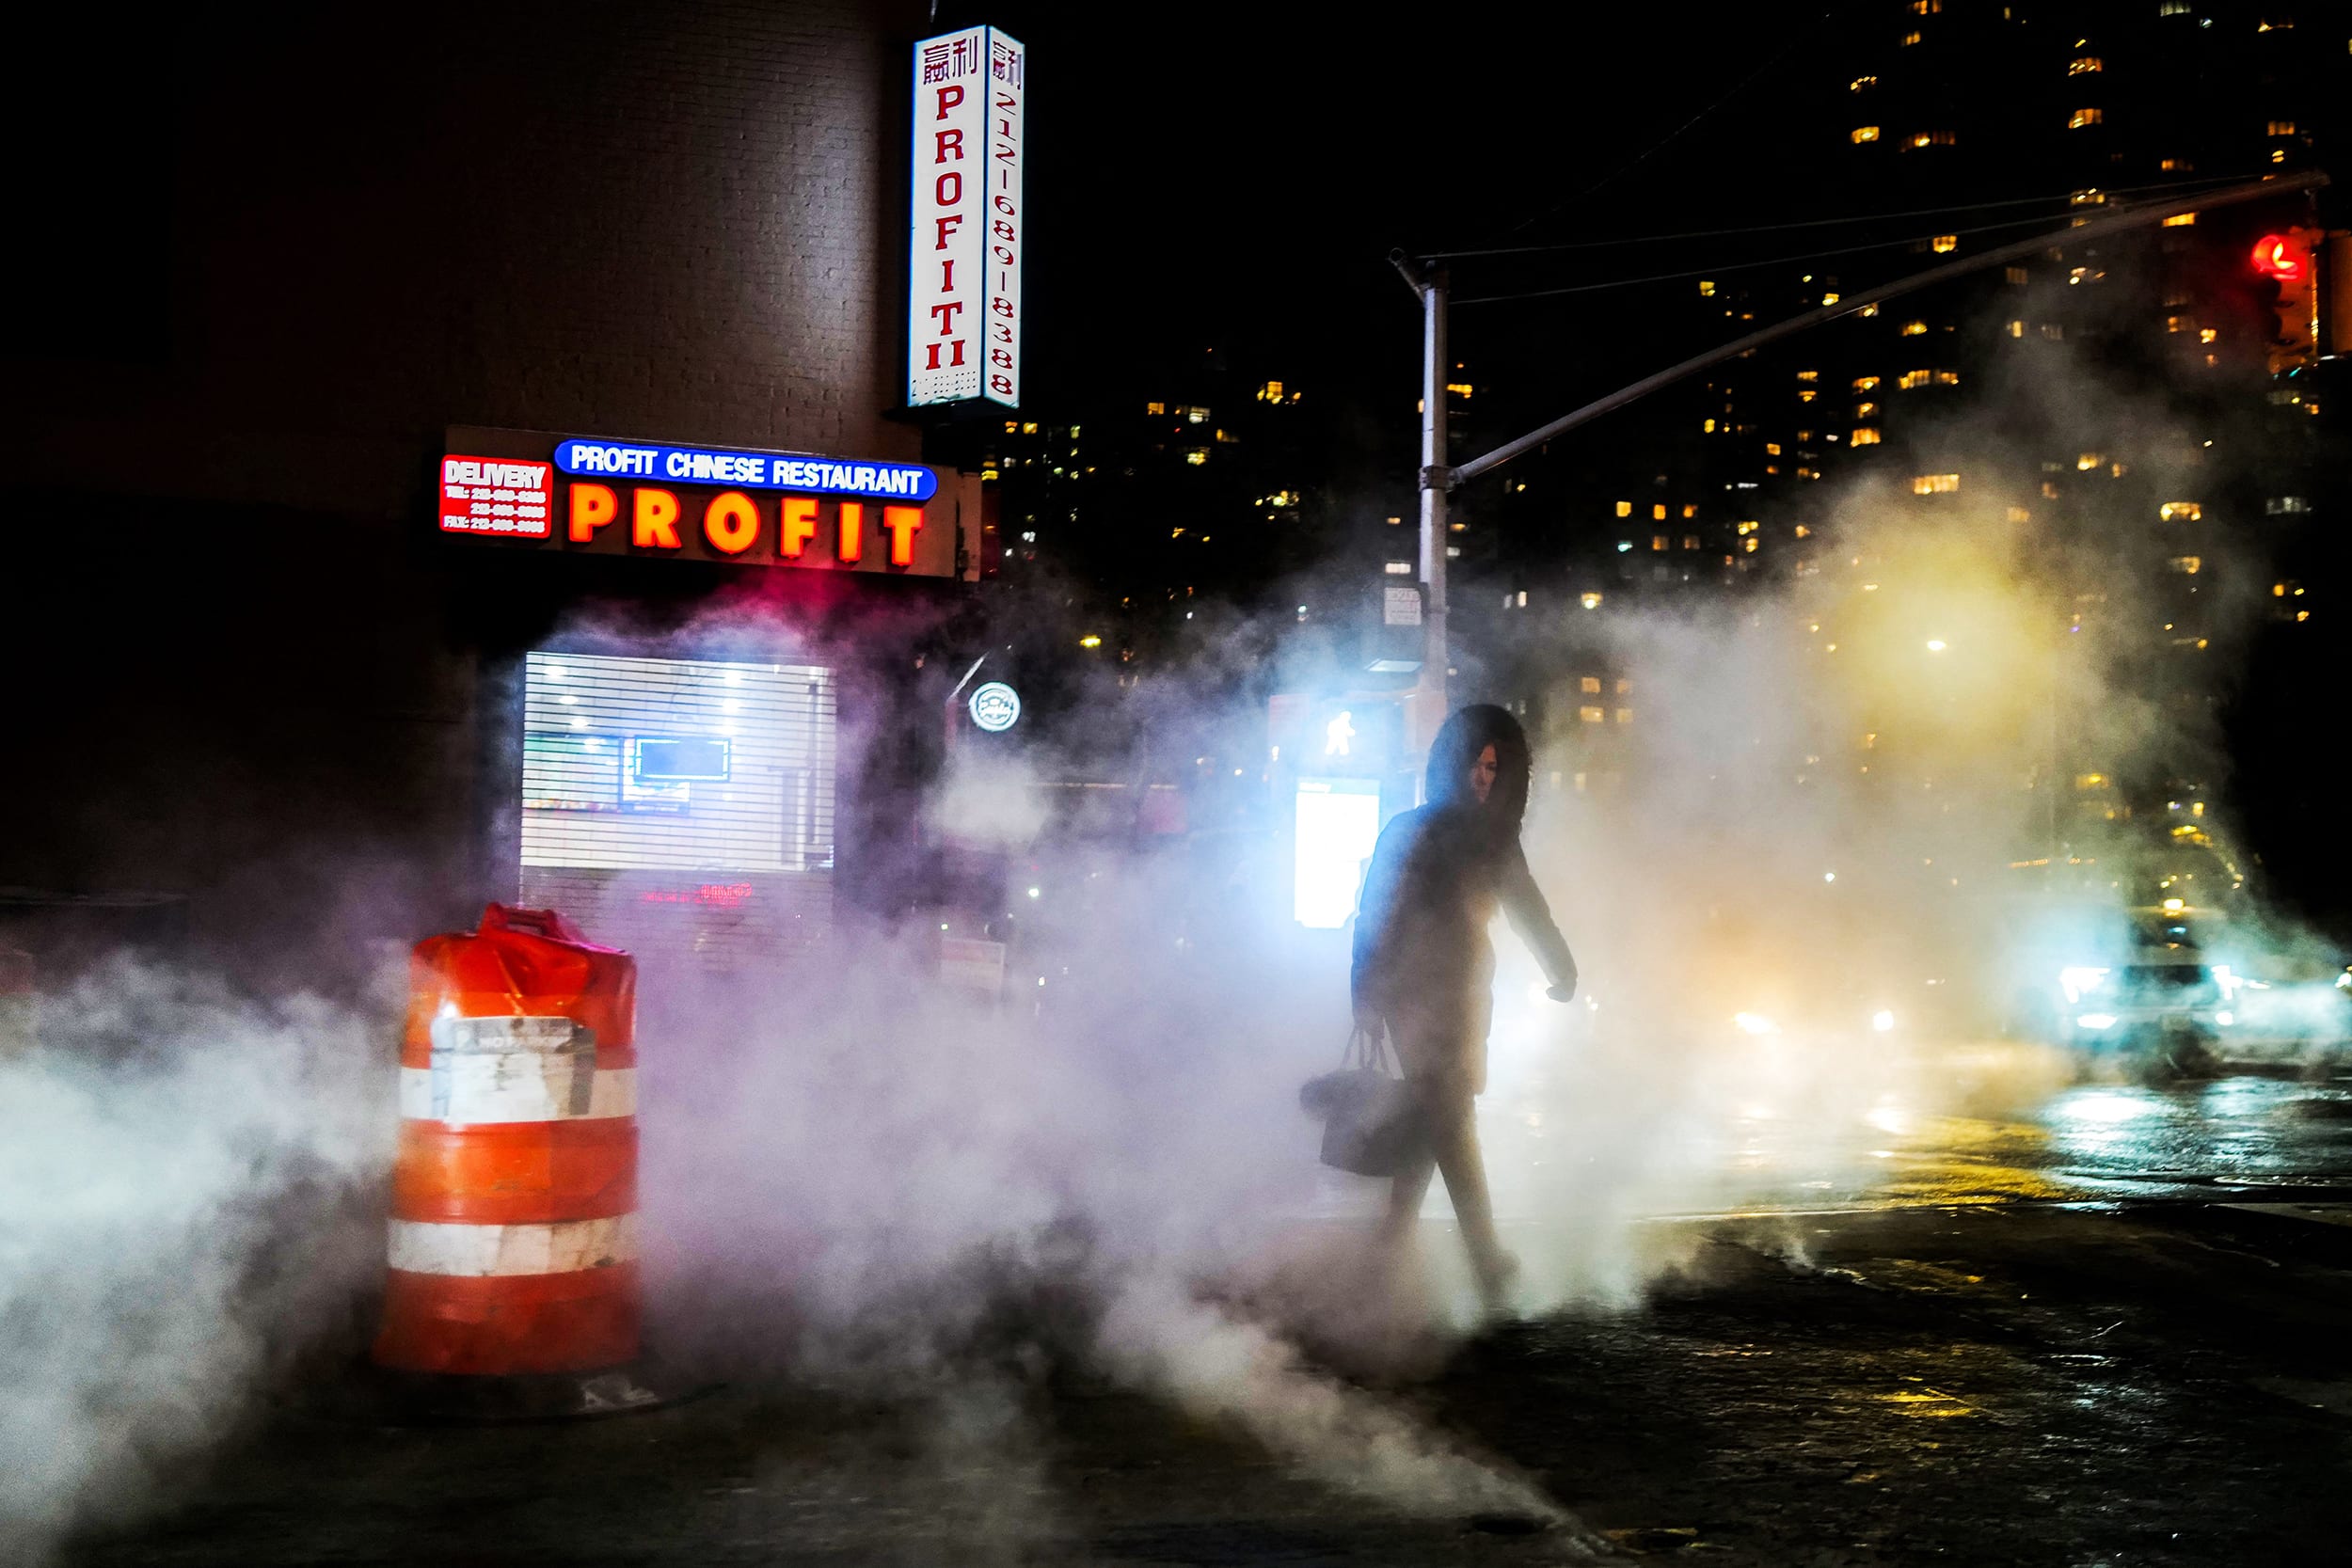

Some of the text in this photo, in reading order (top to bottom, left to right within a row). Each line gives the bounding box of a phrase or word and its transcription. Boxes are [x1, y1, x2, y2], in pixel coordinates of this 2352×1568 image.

[930, 85, 965, 337] PROFIT
[991, 91, 1017, 395] 212-689-8388
[445, 460, 547, 489] DELIVERY
[571, 445, 923, 495] PROFIT CHINESE RESTAURANT
[569, 483, 924, 566] PROFIT
